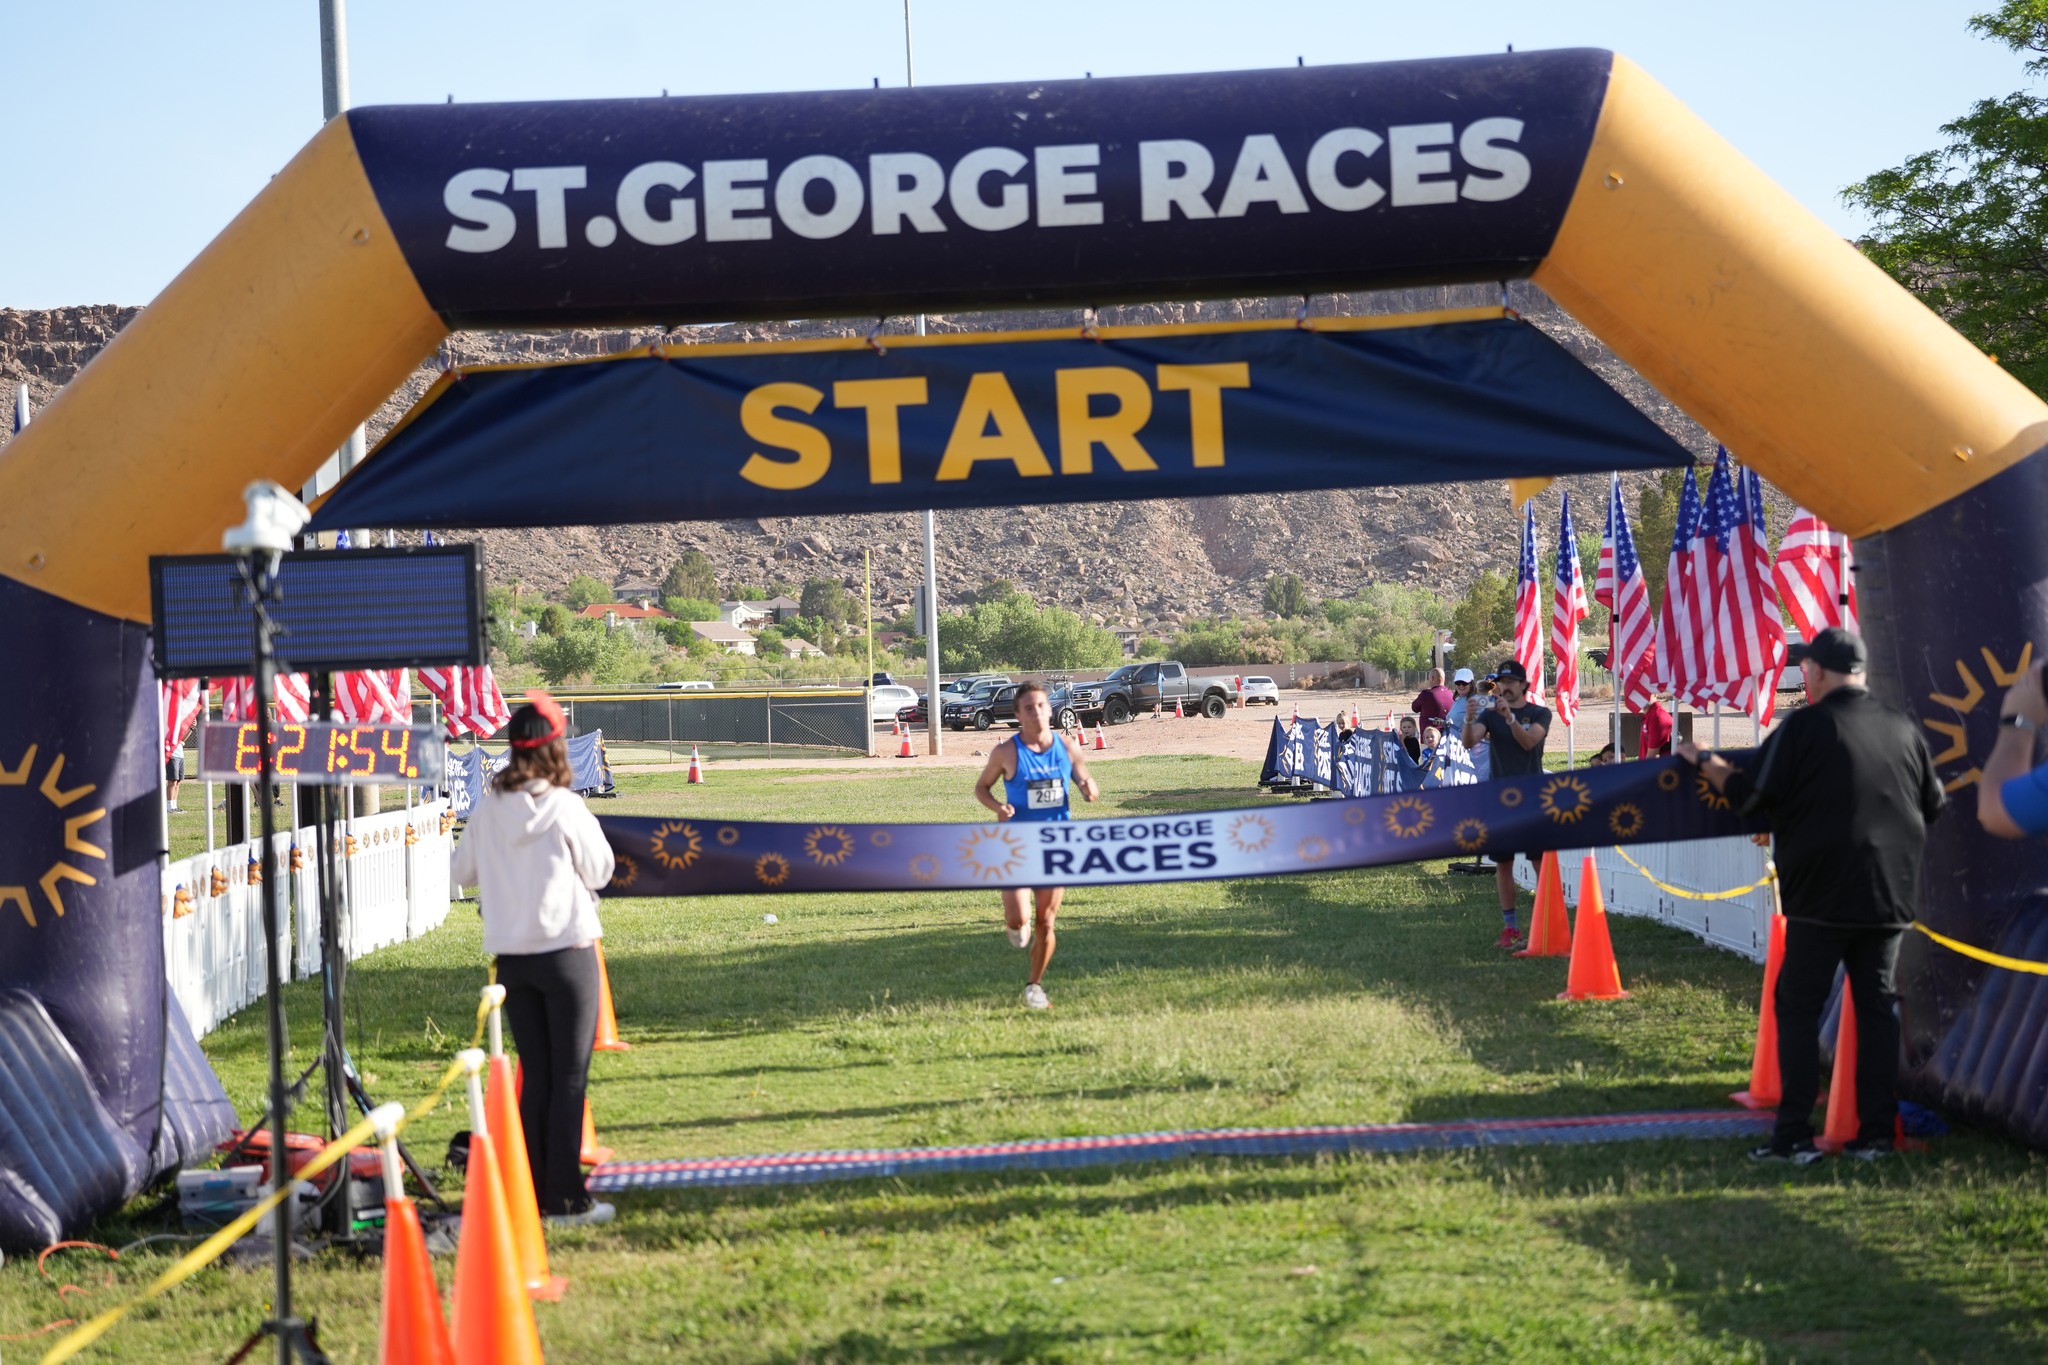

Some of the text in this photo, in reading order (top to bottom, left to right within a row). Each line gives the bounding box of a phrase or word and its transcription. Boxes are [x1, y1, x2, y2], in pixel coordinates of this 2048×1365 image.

[443, 117, 1531, 253] ST.GEORGE RACES
[739, 362, 1251, 490] START
[1039, 819, 1214, 843] ST.GEORGE
[1042, 841, 1217, 876] RACES
